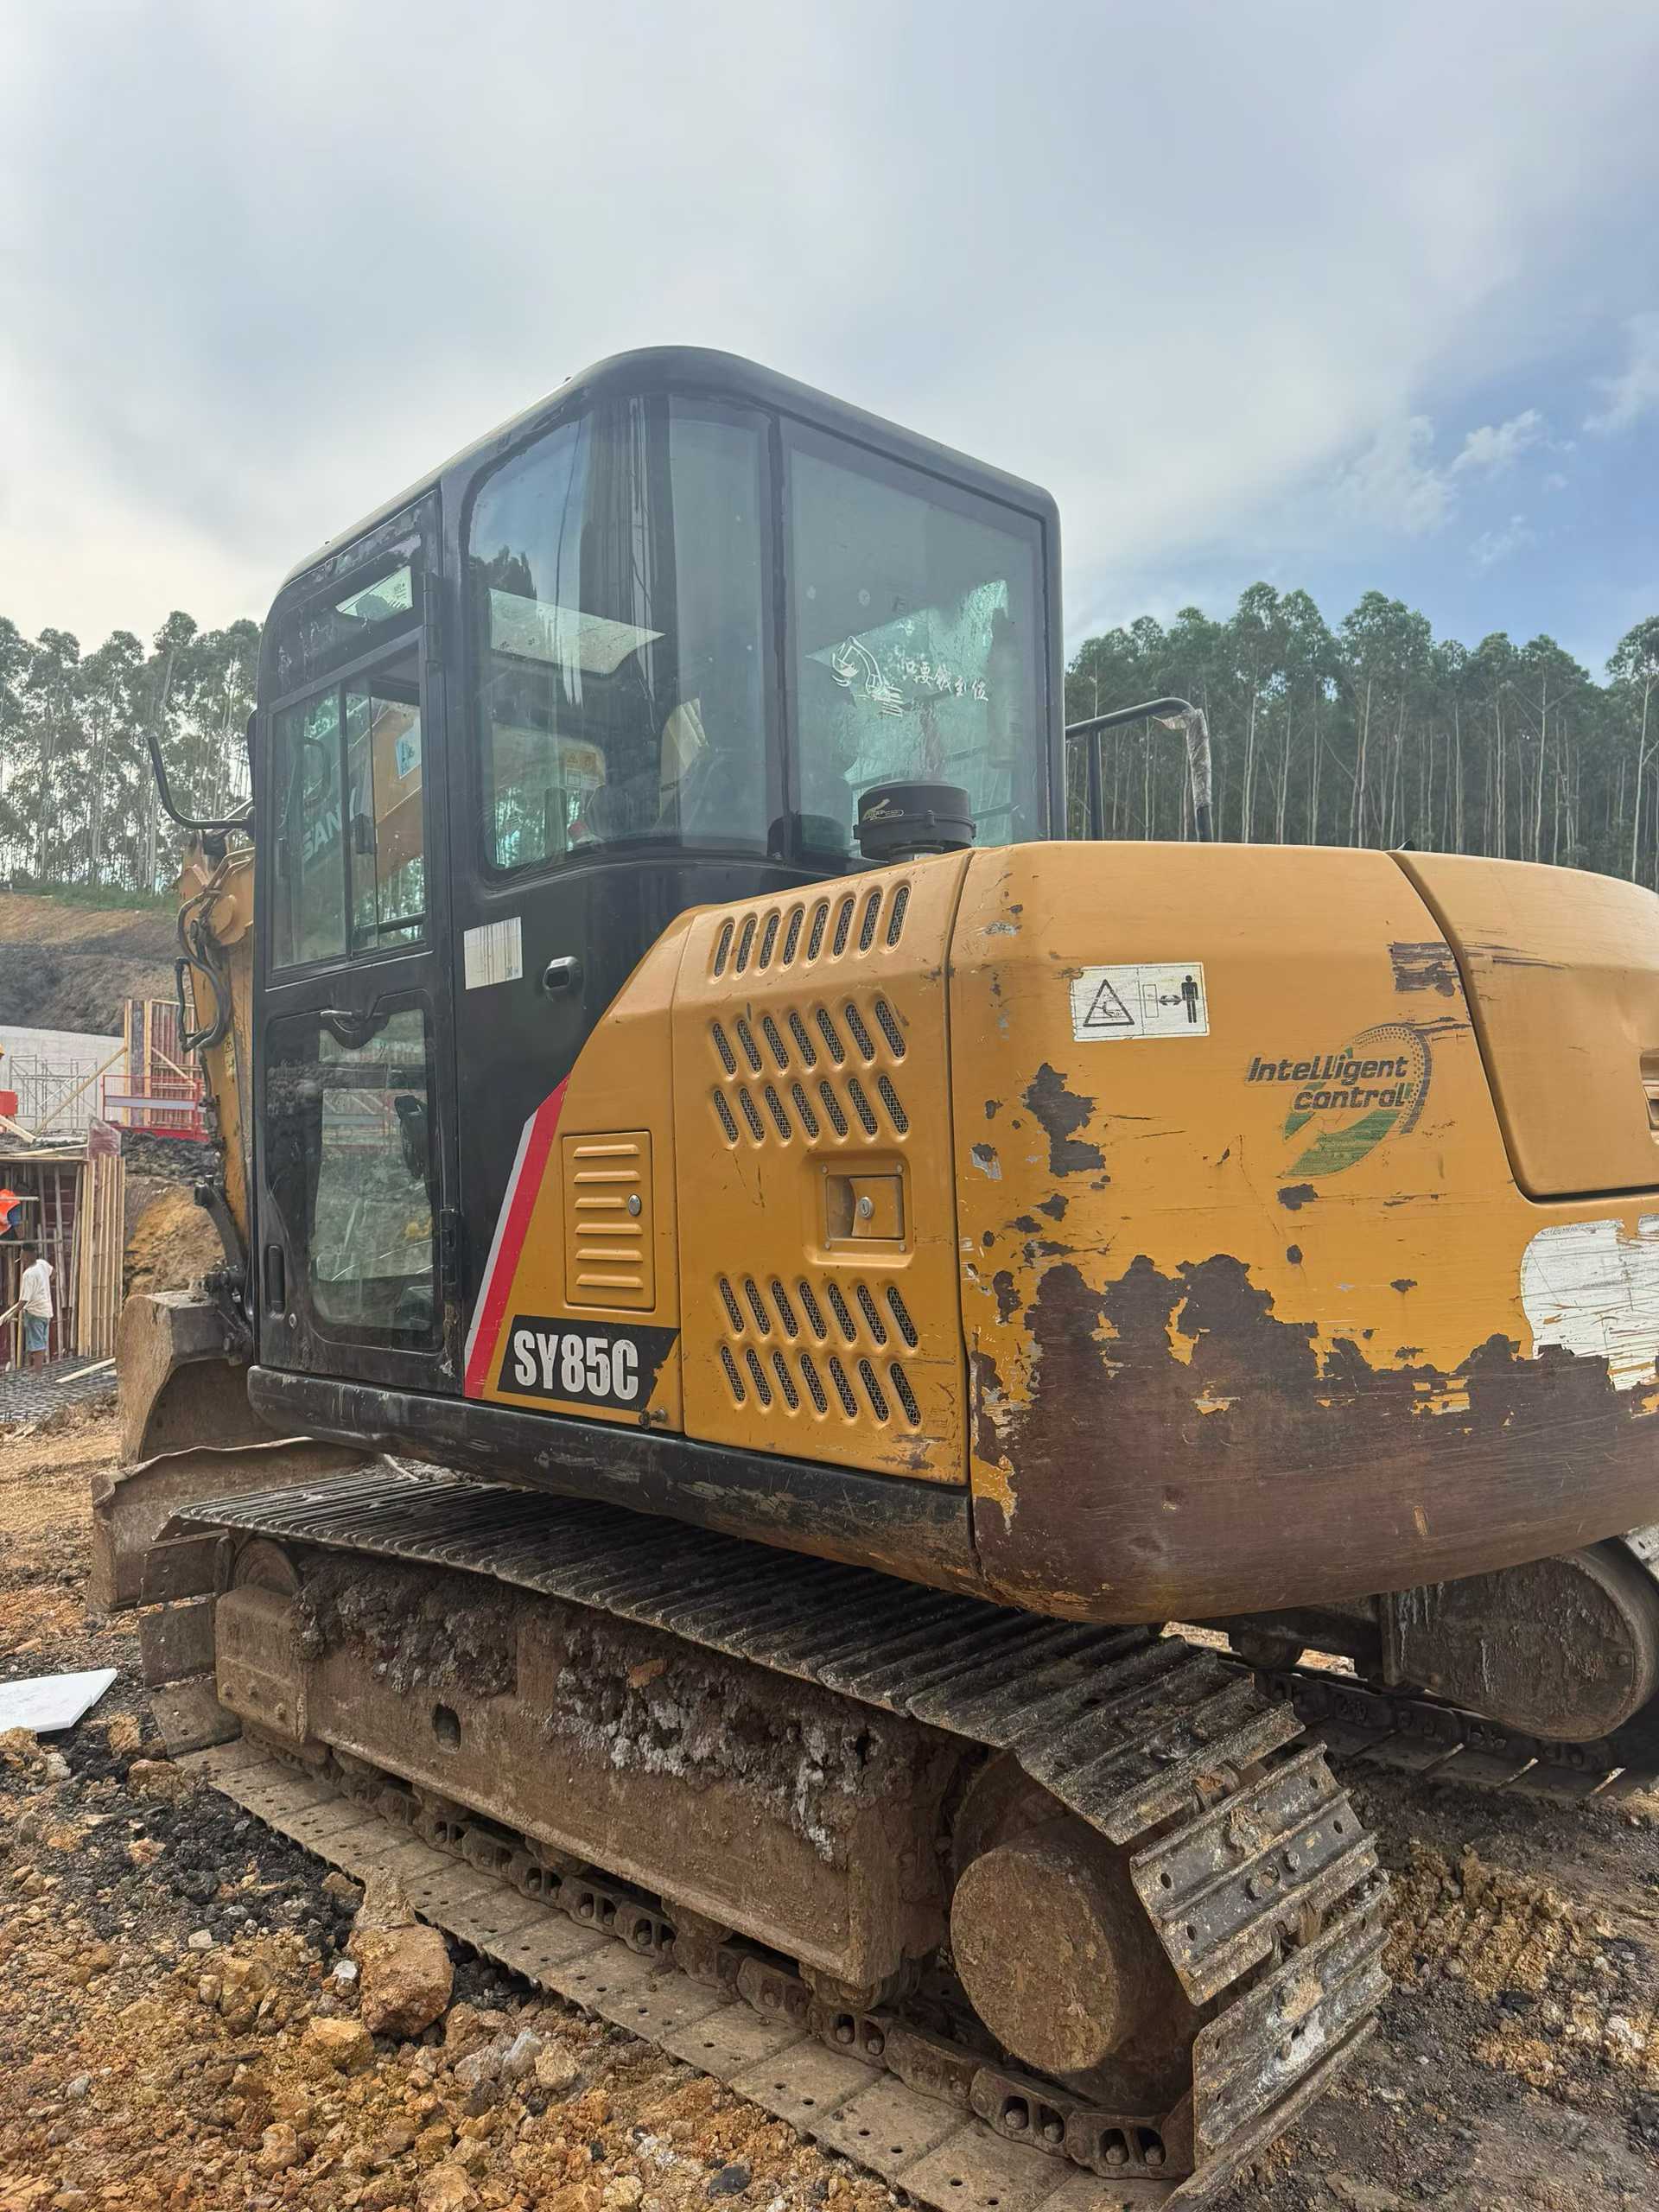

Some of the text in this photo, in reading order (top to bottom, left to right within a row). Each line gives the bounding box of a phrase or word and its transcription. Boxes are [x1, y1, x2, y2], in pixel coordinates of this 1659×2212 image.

[1247, 1054, 1409, 1085] Intelligent
[1294, 1083, 1405, 1110] control
[514, 1330, 639, 1401] SY85C
